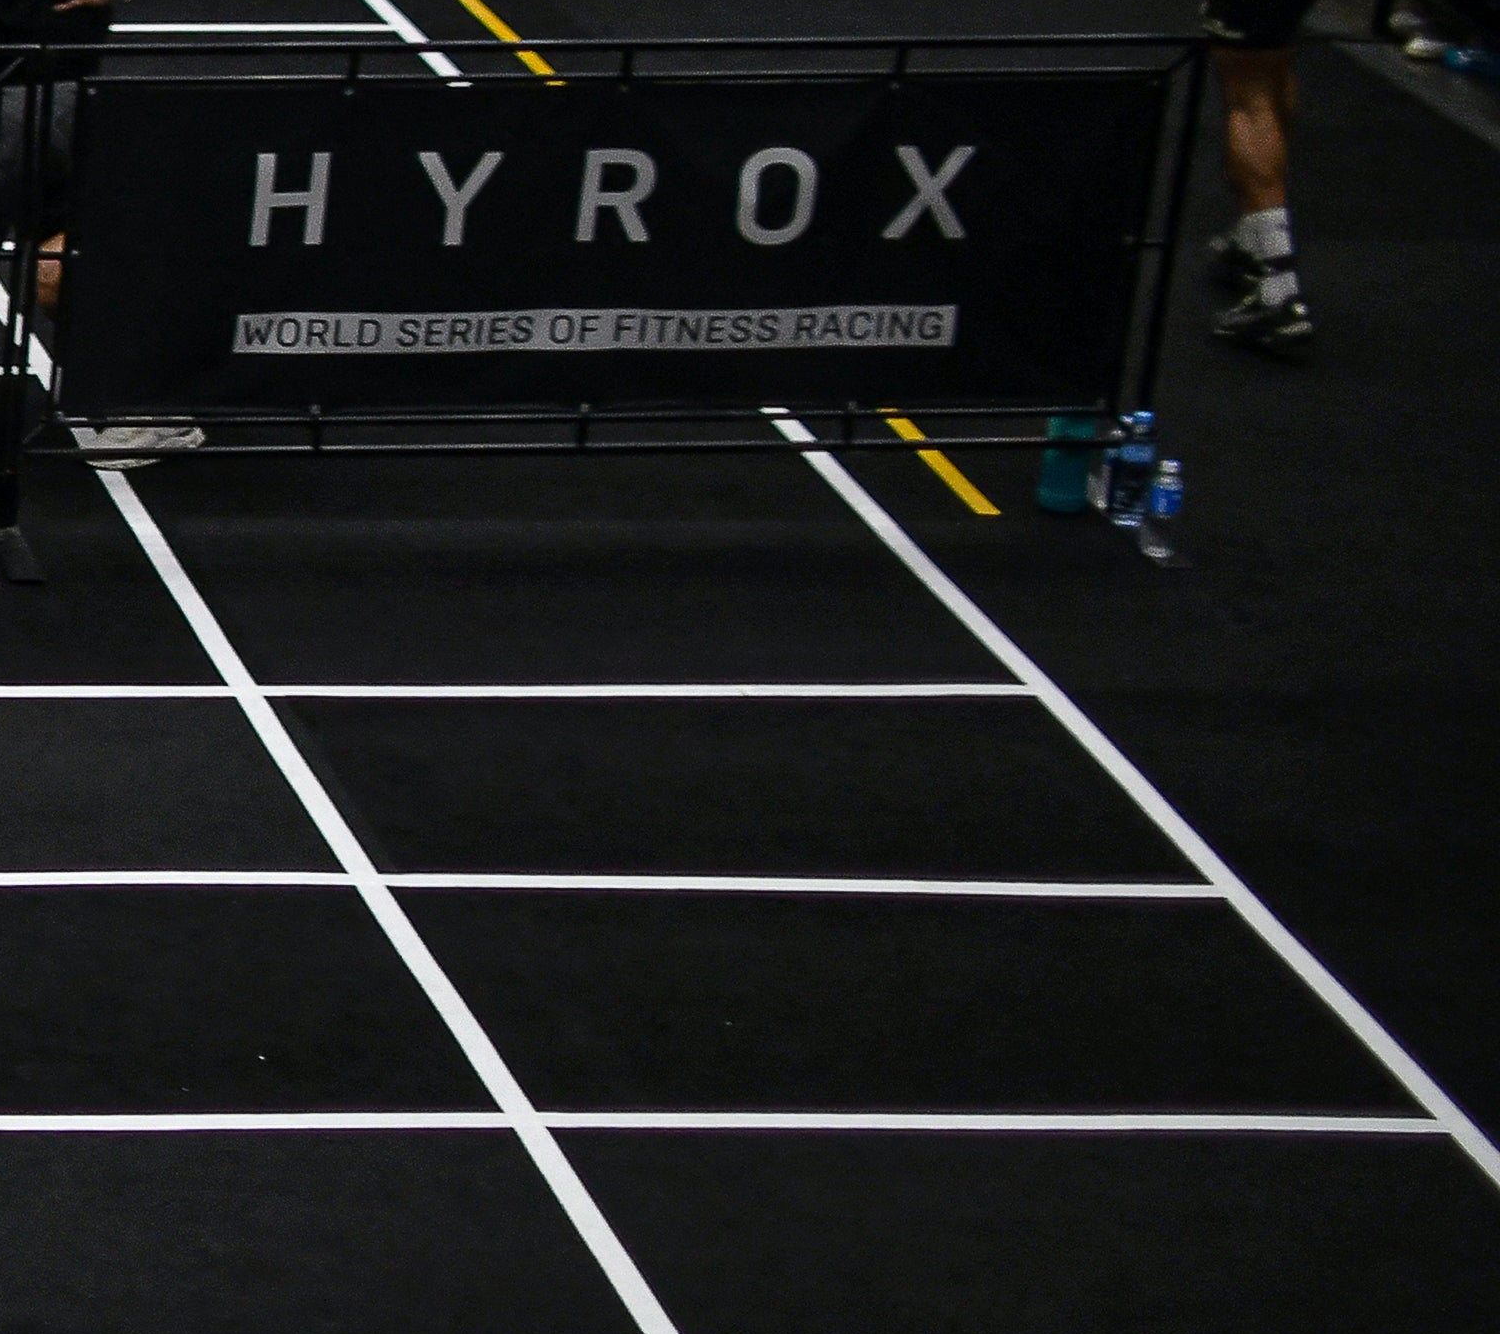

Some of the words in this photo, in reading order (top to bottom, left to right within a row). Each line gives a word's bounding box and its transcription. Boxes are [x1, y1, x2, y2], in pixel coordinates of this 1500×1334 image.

[249, 146, 974, 246] HYROX
[242, 317, 381, 348] WORLD
[397, 316, 535, 347] SERIES
[549, 314, 599, 346] OF
[612, 313, 777, 345] FITNESS
[795, 310, 943, 343] RACING
